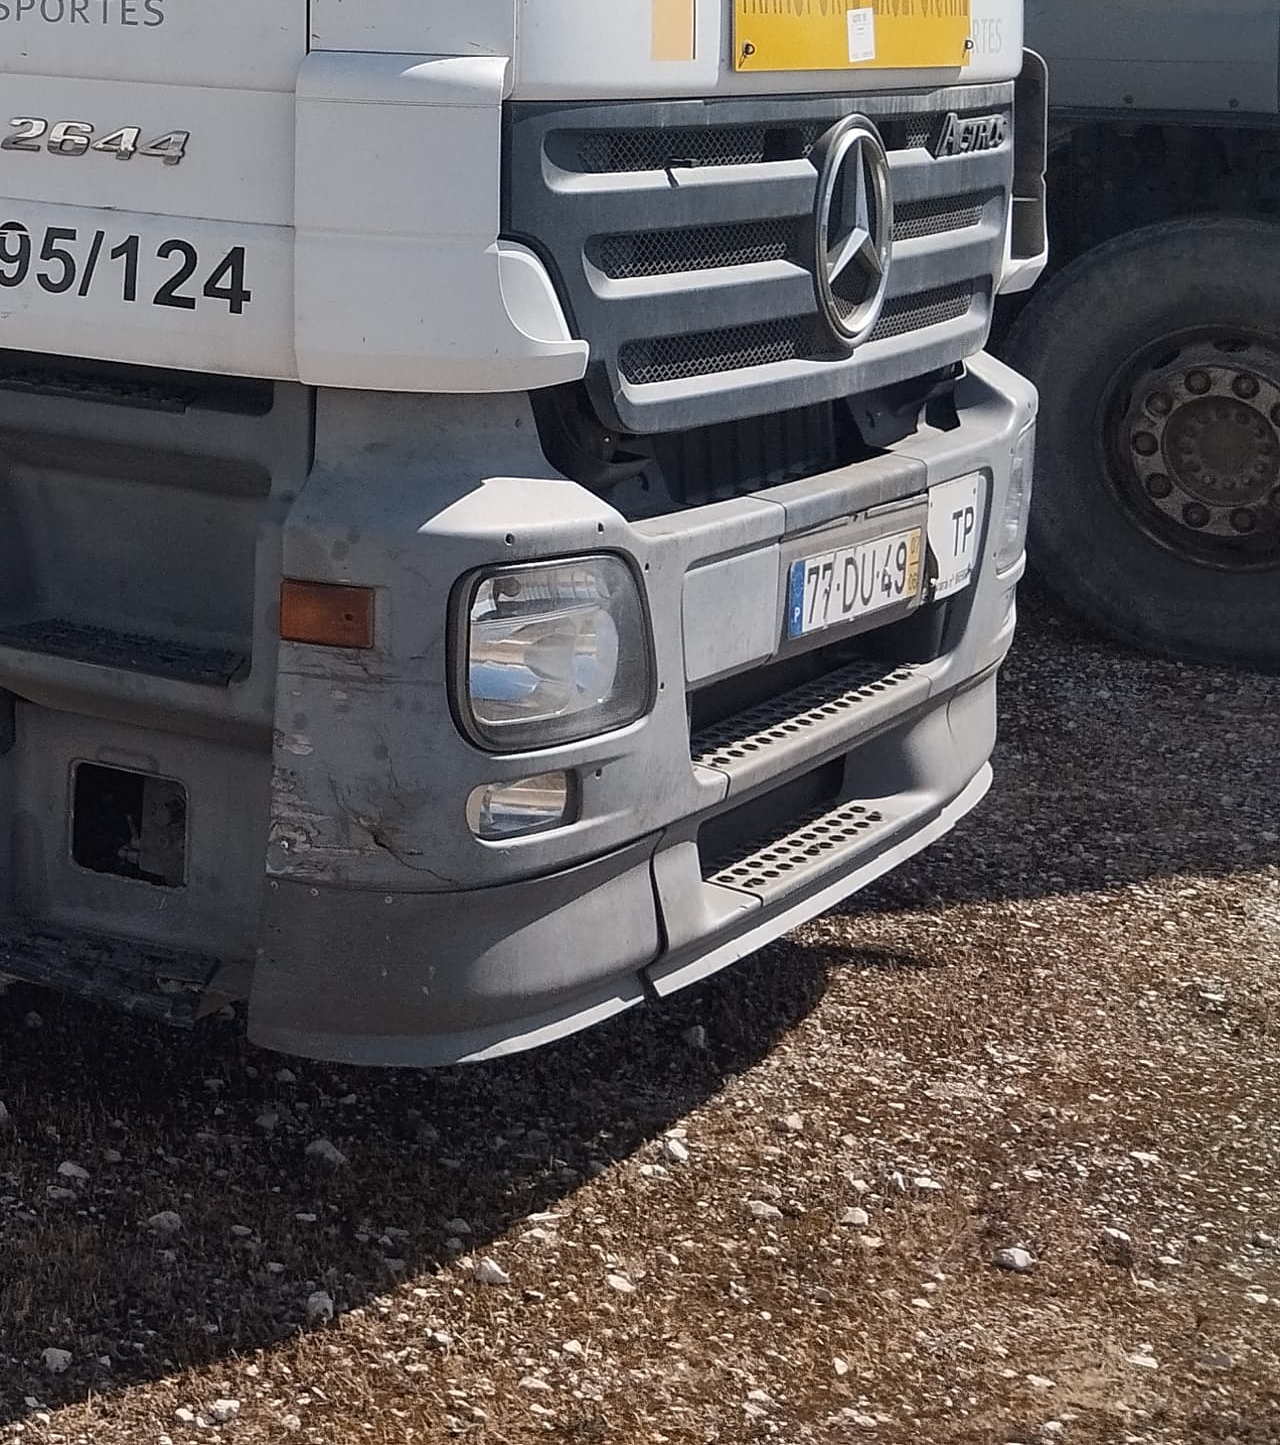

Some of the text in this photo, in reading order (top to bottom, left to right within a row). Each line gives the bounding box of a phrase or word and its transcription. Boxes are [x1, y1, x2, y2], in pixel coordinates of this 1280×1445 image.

[0, 115, 191, 166] 2644
[952, 505, 974, 557] TP
[807, 540, 907, 624] 77-DU-49
[794, 606, 801, 623] P
